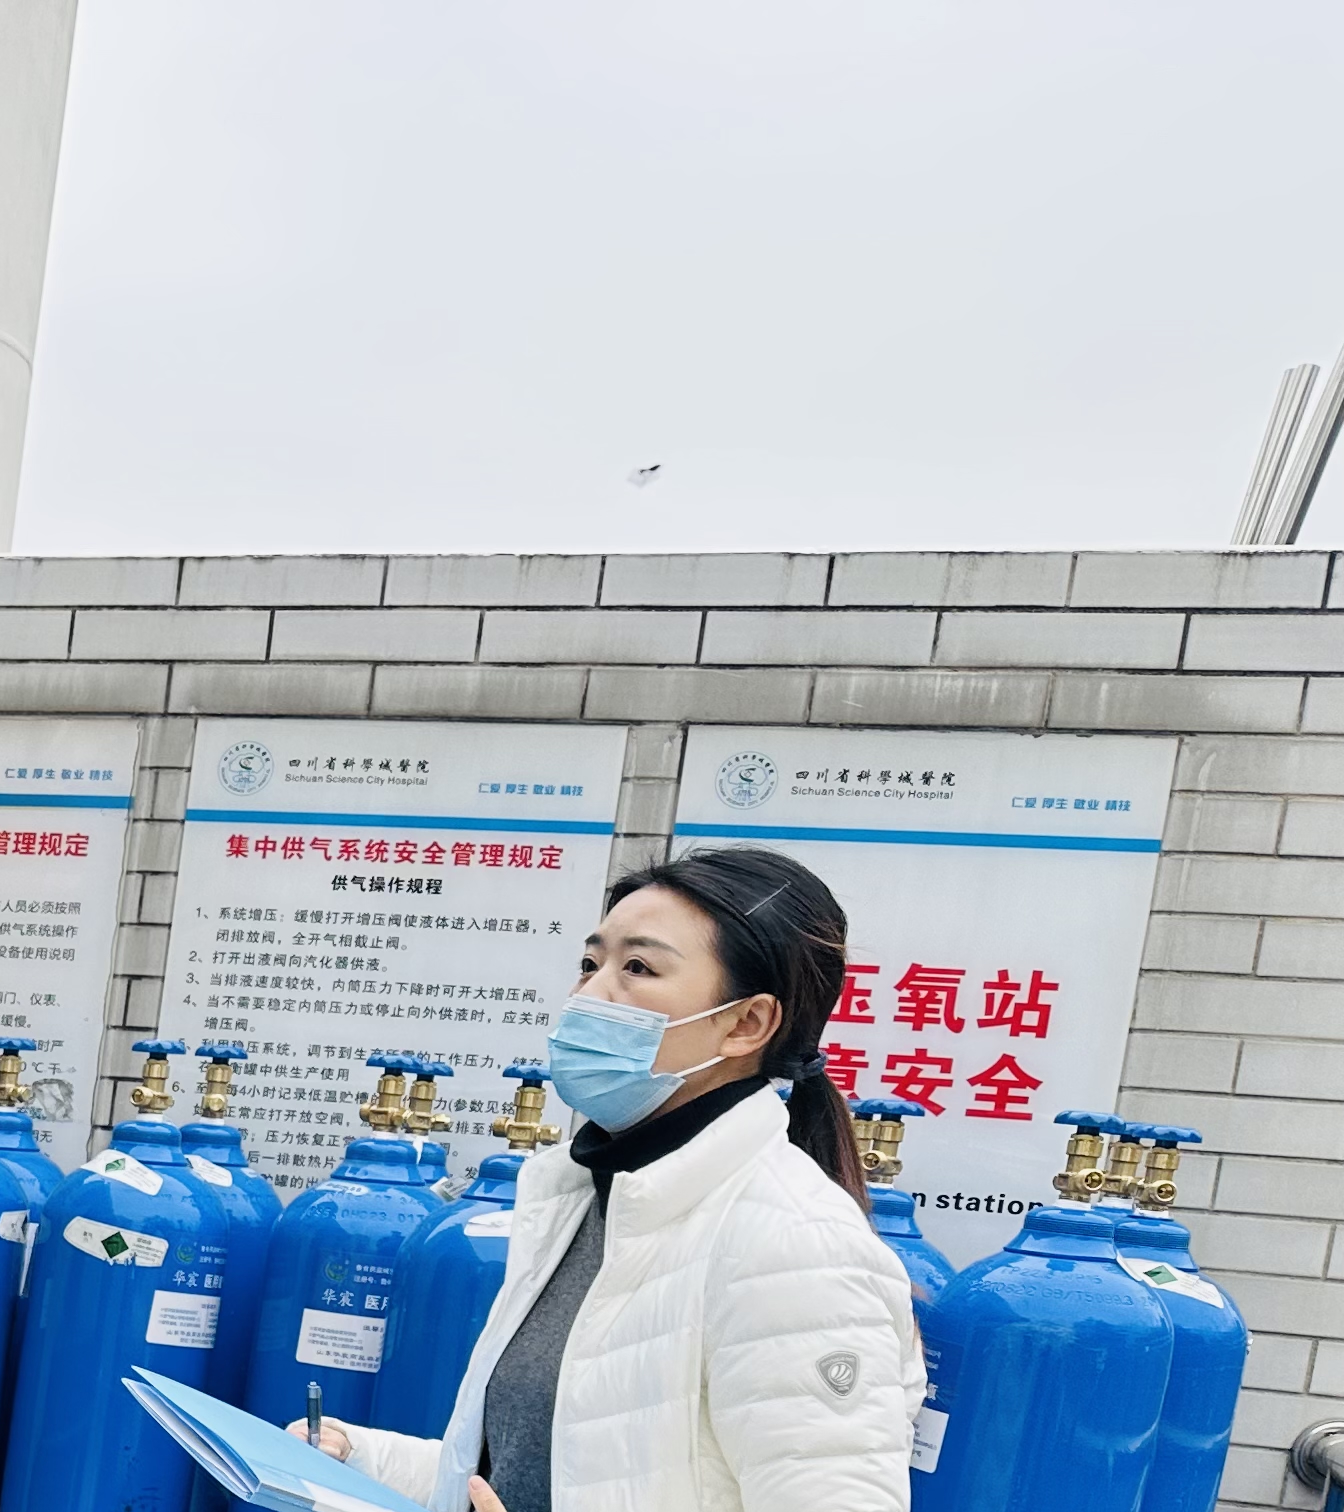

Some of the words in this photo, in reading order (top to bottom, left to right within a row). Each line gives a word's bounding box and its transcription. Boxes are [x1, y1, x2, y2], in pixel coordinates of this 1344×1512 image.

[285, 773, 323, 783] Sichuan
[326, 775, 364, 785] Science
[366, 776, 385, 787] City
[387, 776, 428, 787] Hospital
[791, 786, 834, 797] Sichuan
[837, 787, 881, 799] Science
[883, 788, 905, 802] City
[908, 789, 954, 802] Hospital
[1011, 796, 1037, 809] 仁爱
[226, 834, 565, 870] 集中供气系统安全管理规定
[331, 875, 443, 895] 供气操作规程
[204, 1016, 256, 1033] 增压阀。
[936, 1190, 1044, 1216] station
